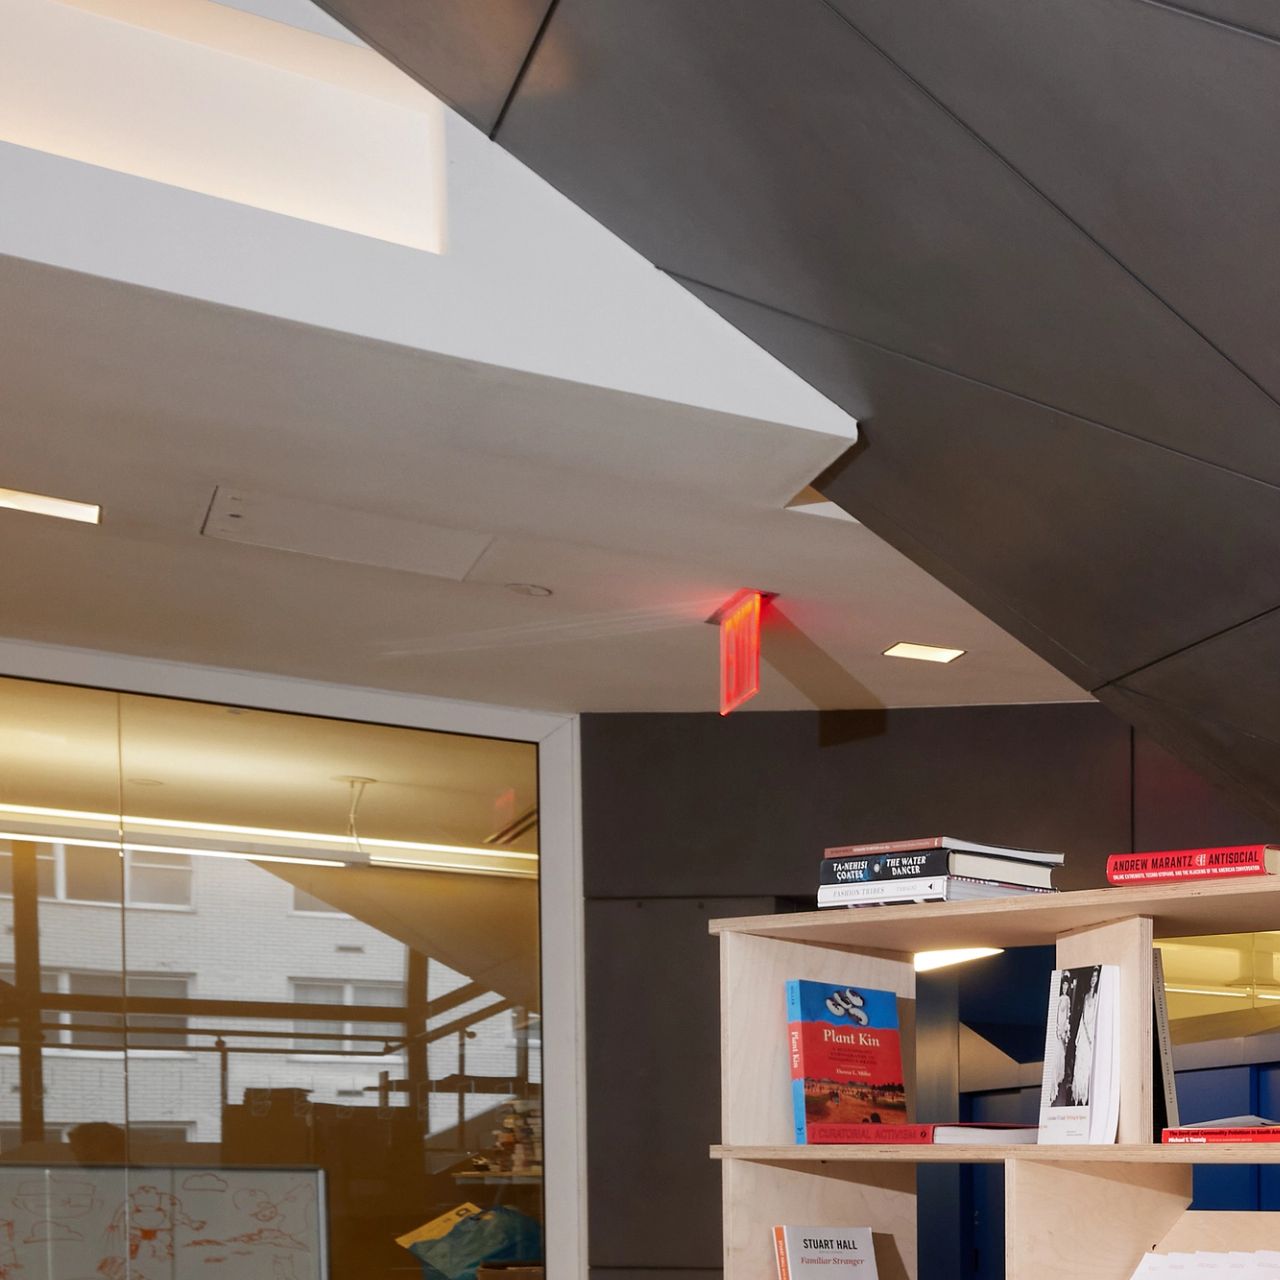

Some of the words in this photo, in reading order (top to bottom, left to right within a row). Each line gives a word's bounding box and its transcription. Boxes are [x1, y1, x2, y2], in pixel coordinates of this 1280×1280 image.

[833, 860, 868, 871] TA-NEHISI
[886, 859, 900, 867] THE
[901, 856, 927, 866] WATER
[1113, 857, 1148, 872] ANDREW
[1151, 855, 1193, 869] MARANTZ
[1208, 850, 1259, 865] ANTISOCIAL
[836, 870, 864, 880] COATES
[892, 865, 921, 876] DANCER
[823, 1029, 855, 1045] Plant
[859, 1033, 880, 1047] Kin
[803, 1239, 833, 1250] STUART
[836, 1240, 858, 1250] HALL
[800, 1257, 831, 1265] Familiar
[833, 1257, 864, 1266] Stranger
